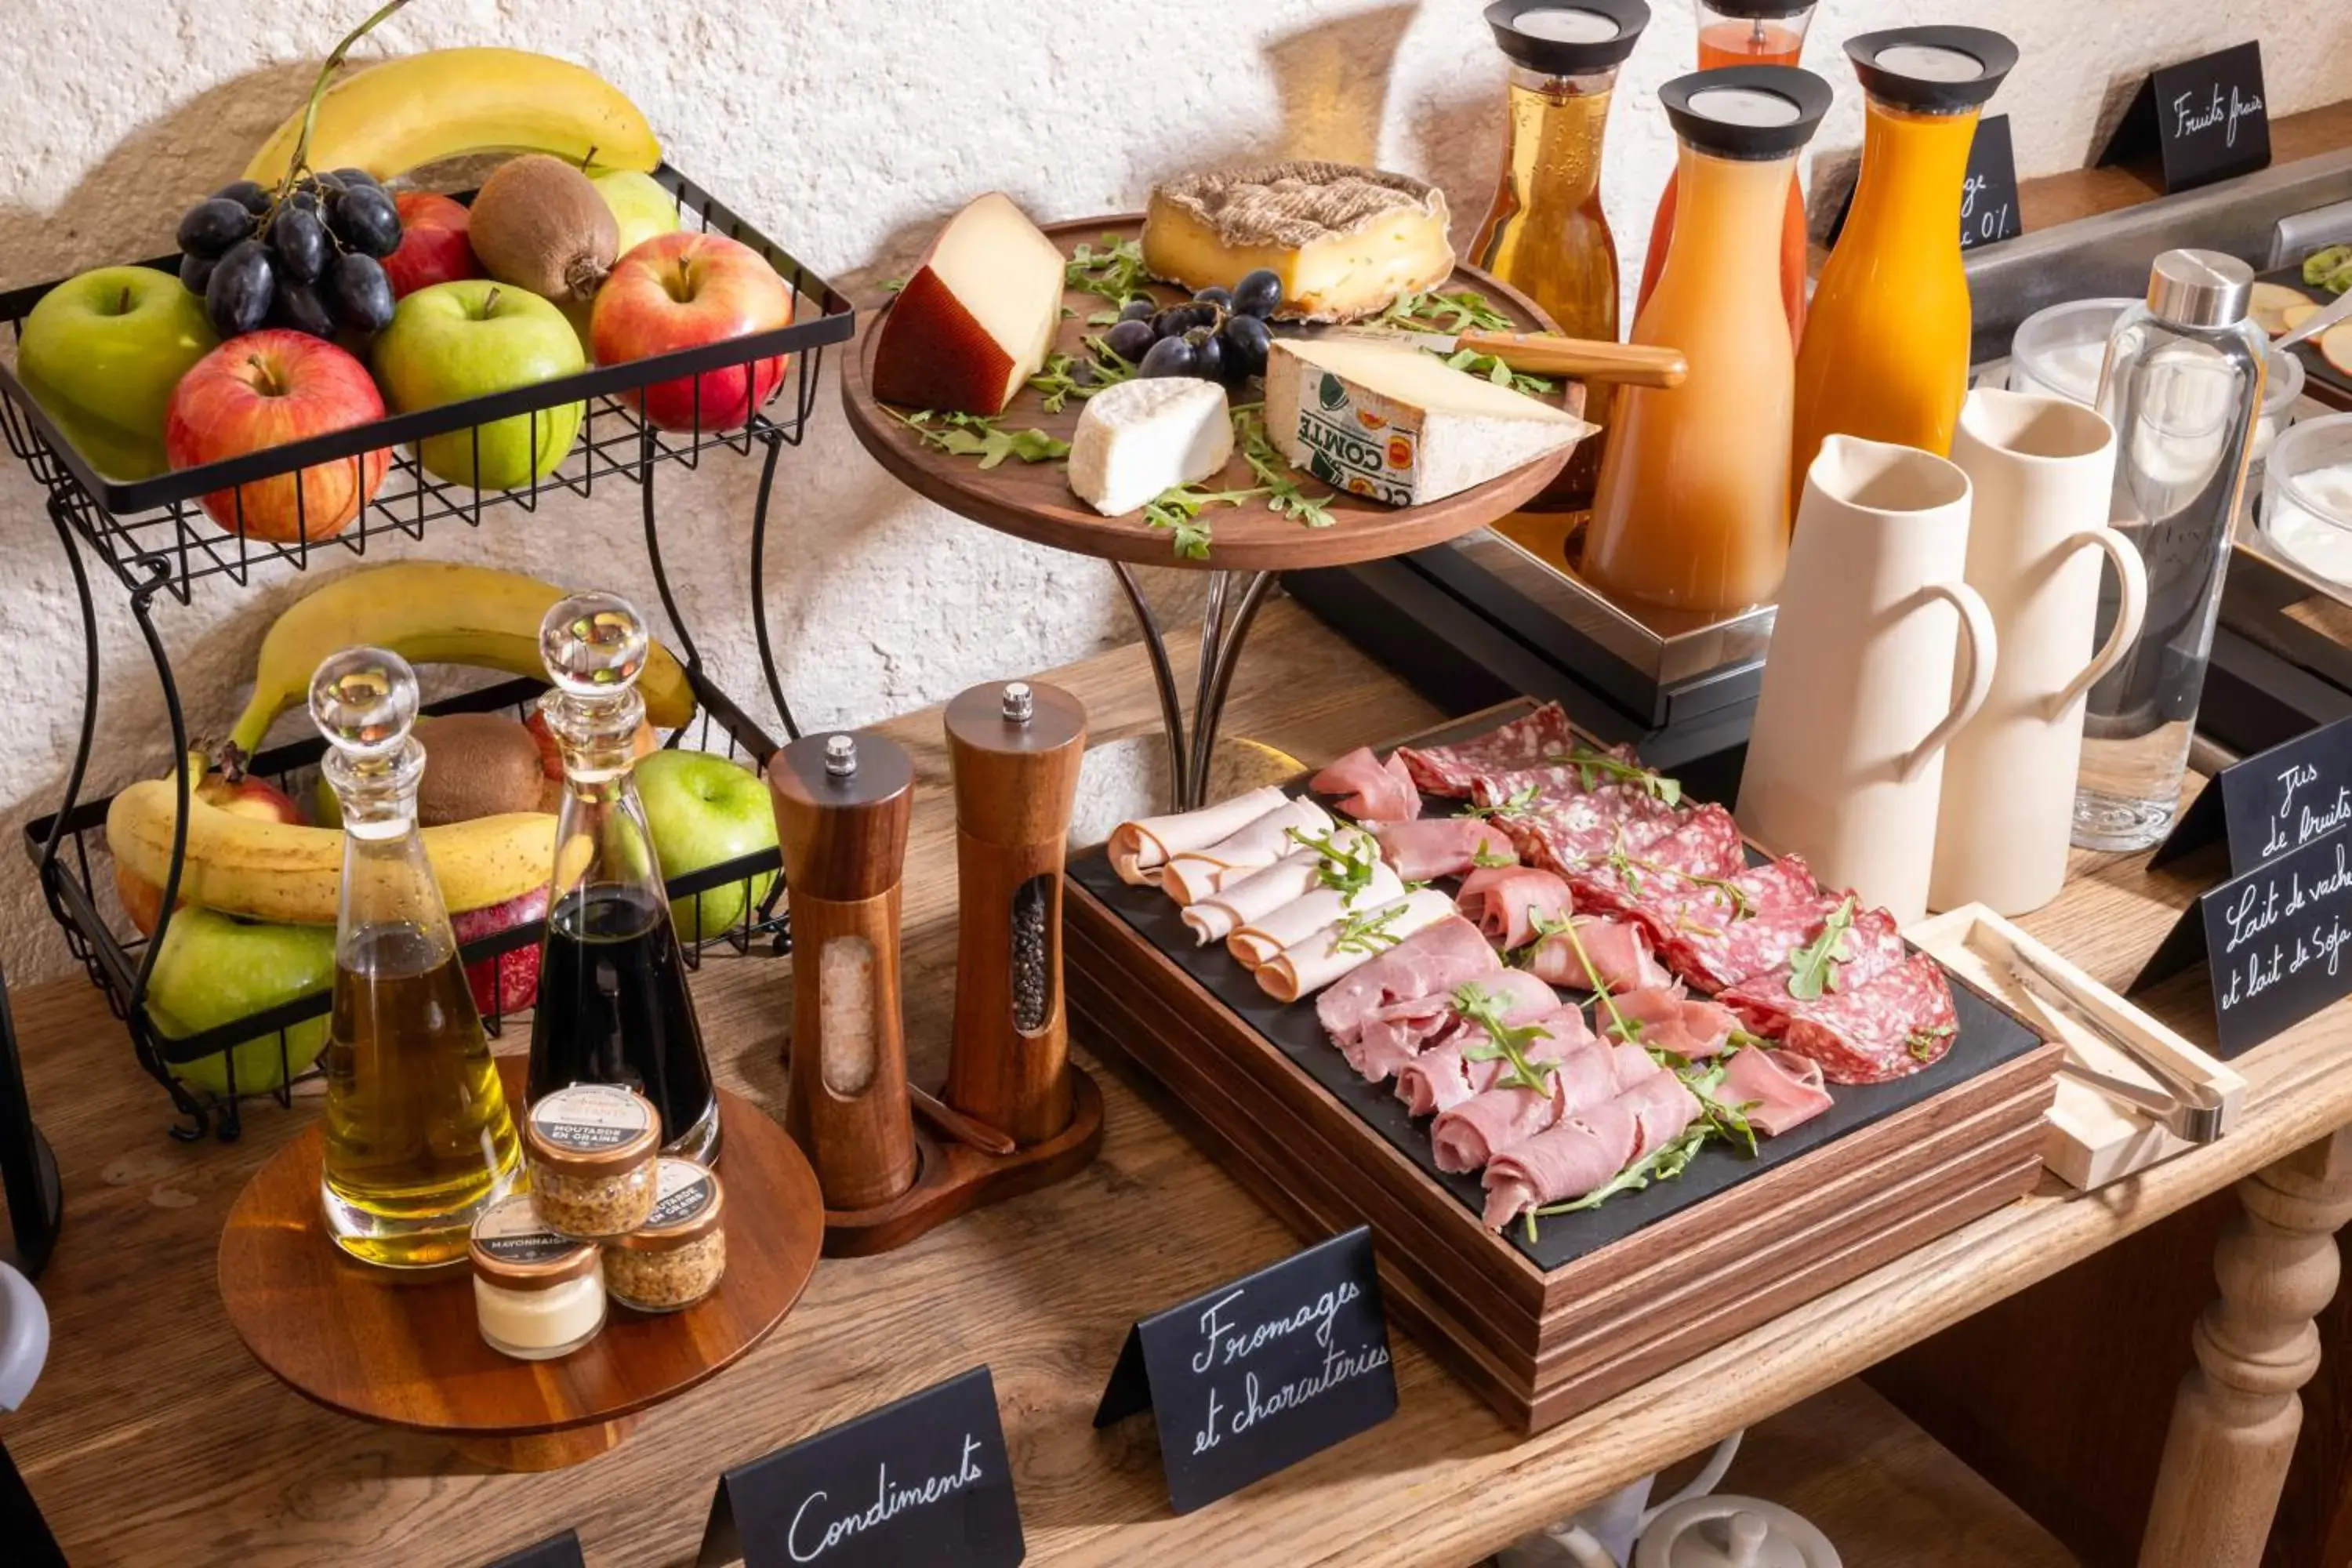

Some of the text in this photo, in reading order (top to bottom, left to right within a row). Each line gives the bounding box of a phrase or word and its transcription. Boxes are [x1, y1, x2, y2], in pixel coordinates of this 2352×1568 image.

[2173, 82, 2263, 148] Fruits frais
[2262, 785, 2351, 857] de fruits
[2277, 763, 2318, 818] Jus
[2225, 843, 2352, 953] Lait de vache
[2222, 968, 2241, 1010] et
[2245, 944, 2284, 997] lait
[2288, 938, 2310, 973] de
[1192, 1281, 1360, 1373] Fromages
[1192, 1387, 1224, 1456] et
[788, 1432, 982, 1562] Condiments
